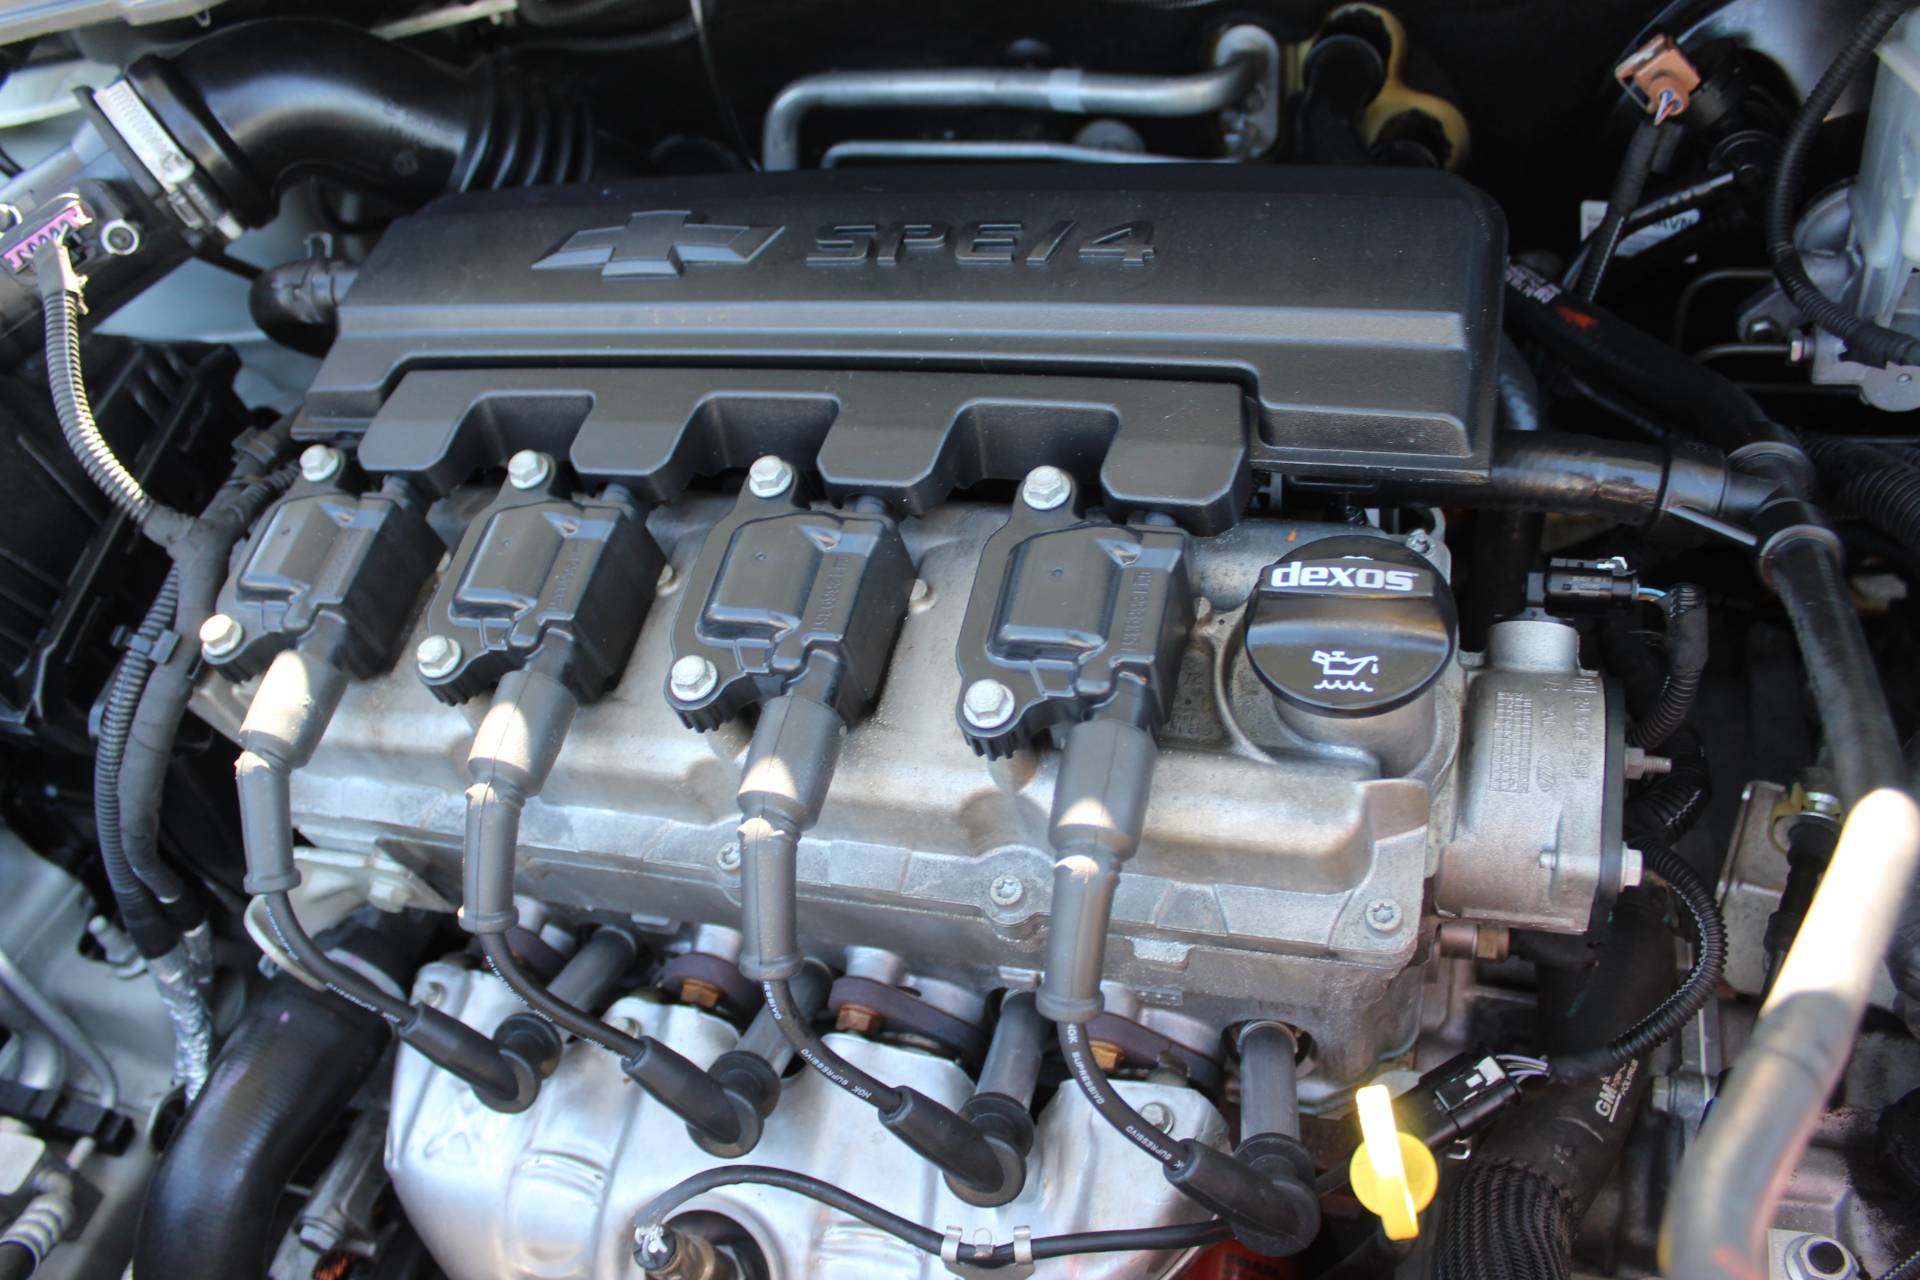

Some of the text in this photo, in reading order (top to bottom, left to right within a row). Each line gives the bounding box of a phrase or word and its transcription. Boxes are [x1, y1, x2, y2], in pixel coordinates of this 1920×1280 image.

[806, 220, 1155, 264] SPE/4
[1271, 561, 1419, 591] dexos
[1595, 1083, 1617, 1117] GM
